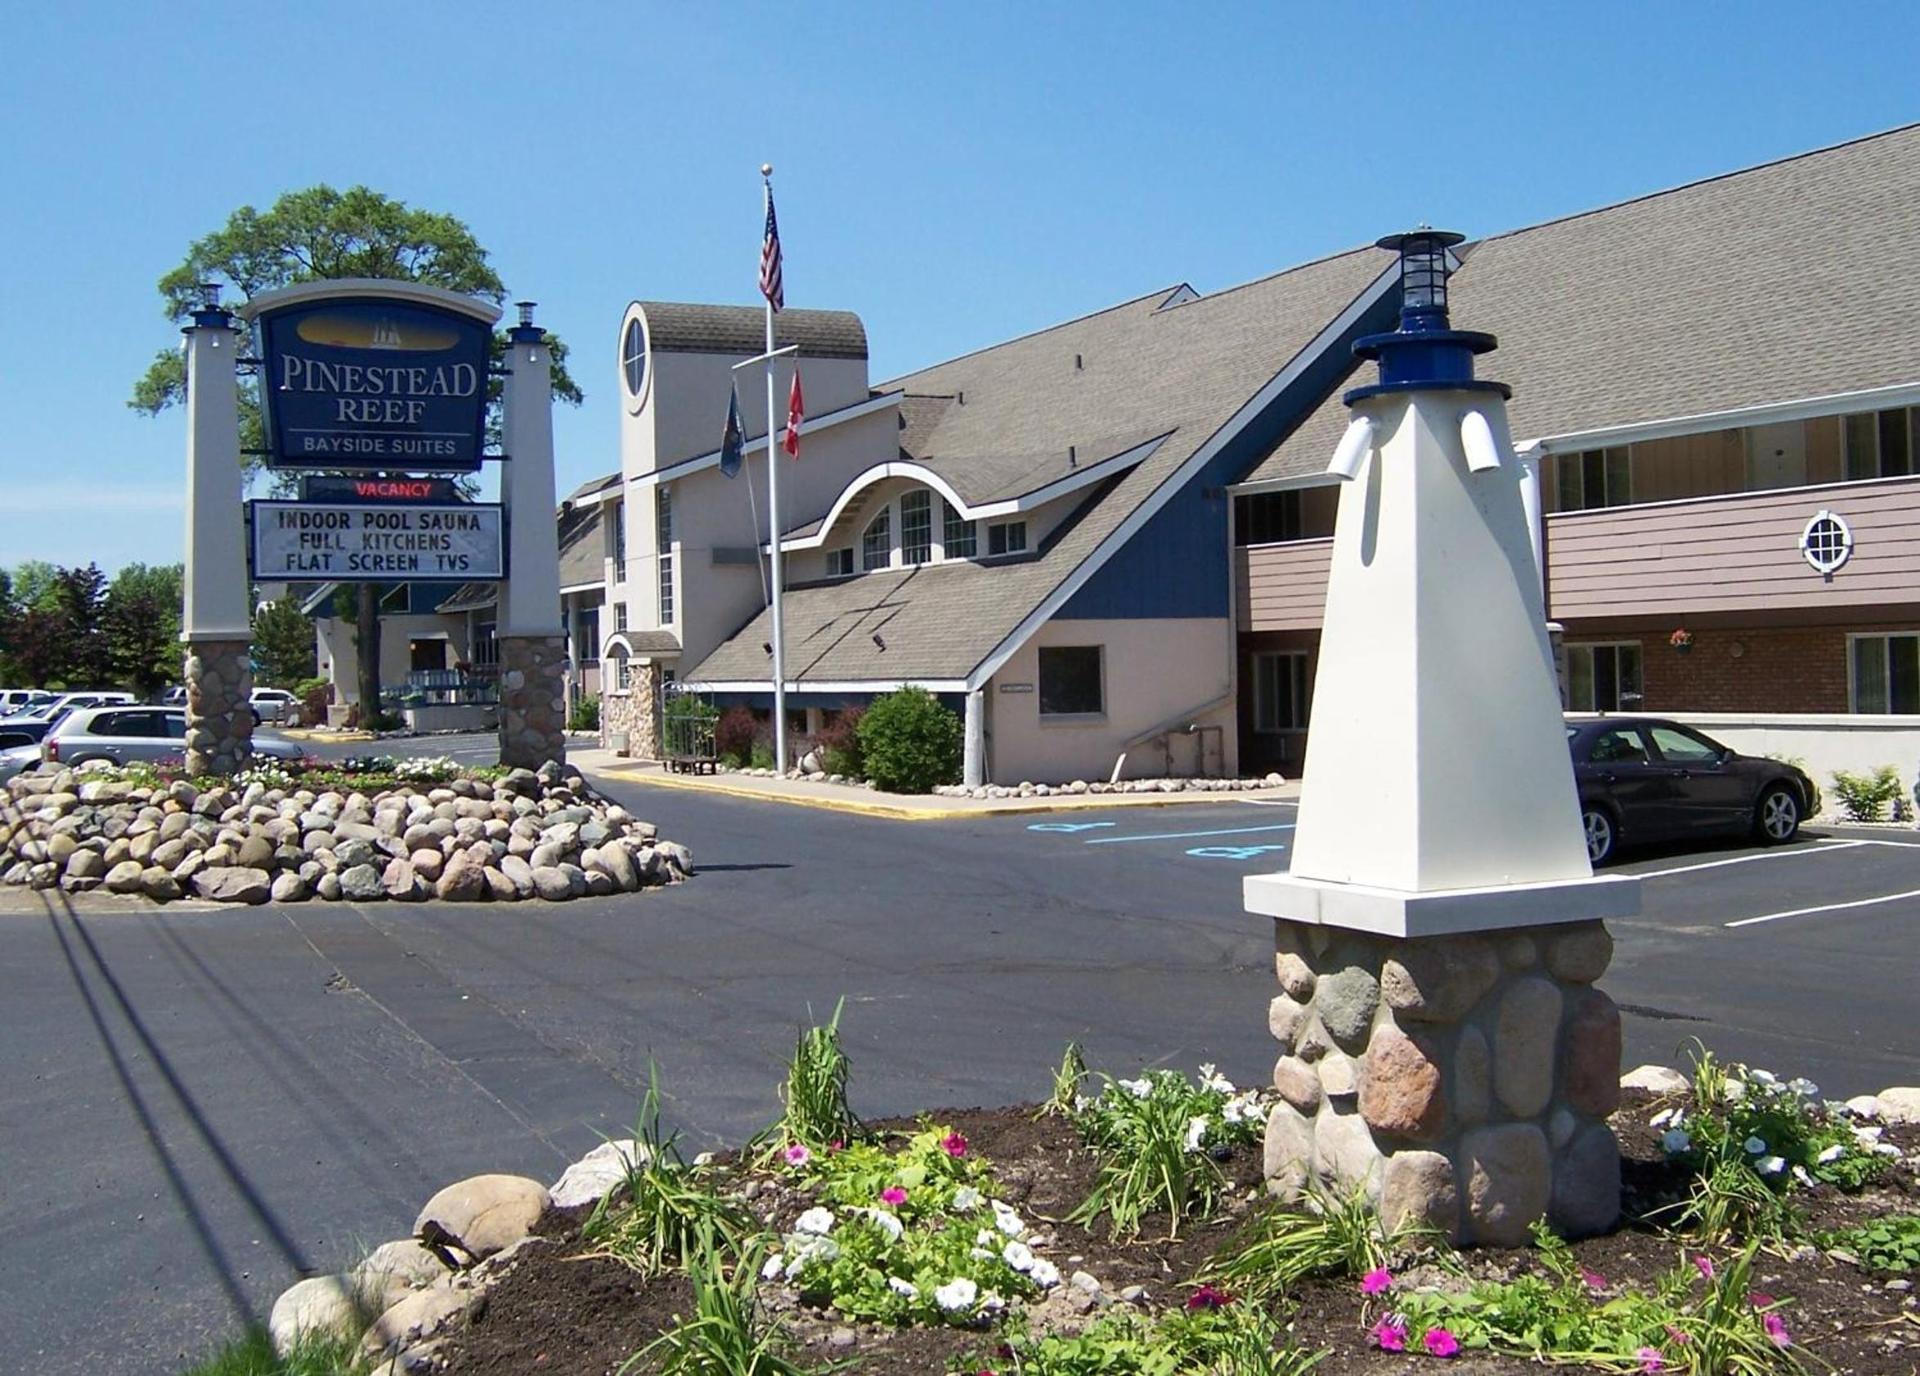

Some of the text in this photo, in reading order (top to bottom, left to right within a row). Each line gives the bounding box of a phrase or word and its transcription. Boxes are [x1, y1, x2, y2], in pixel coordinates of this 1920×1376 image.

[280, 354, 477, 398] PINESTEAD
[336, 399, 426, 424] REEF
[304, 436, 456, 455] BAYSIDE SUITES
[354, 481, 432, 497] VACANCY
[278, 511, 481, 531] INDOOR POOL SAUNA
[300, 532, 451, 551] FULL KITCHENS
[286, 553, 469, 571] FLAT SCREEN TVS
